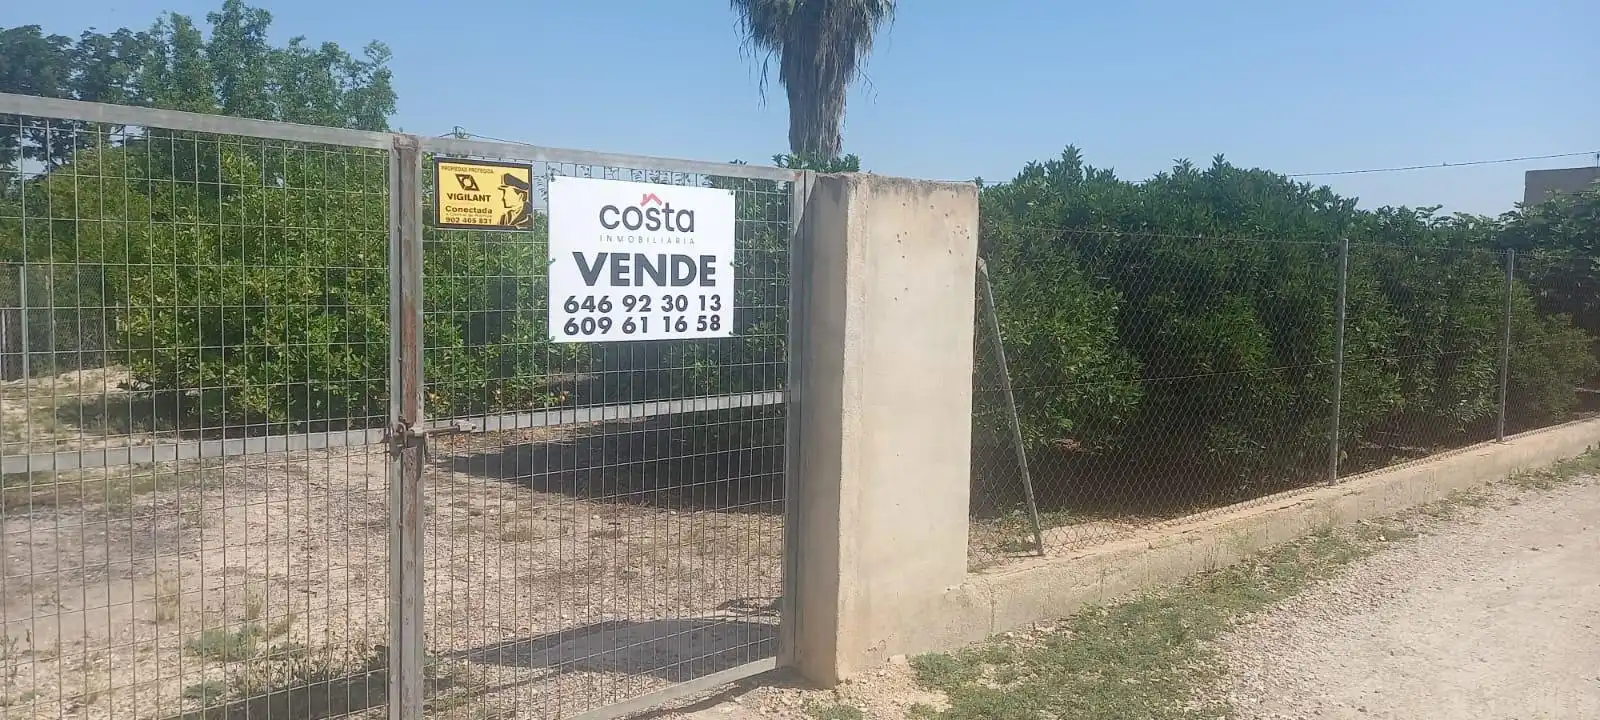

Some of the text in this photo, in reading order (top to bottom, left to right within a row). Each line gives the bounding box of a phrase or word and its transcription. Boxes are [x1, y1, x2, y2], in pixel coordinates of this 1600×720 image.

[446, 192, 491, 202] VIGILANT
[445, 205, 492, 214] Conectada
[599, 202, 695, 233] costa
[600, 235, 695, 245] INMOBILIARIA
[572, 251, 717, 287] VENDE
[563, 294, 722, 314] 646 92 30 13
[563, 315, 721, 336] 609 61 16 58
